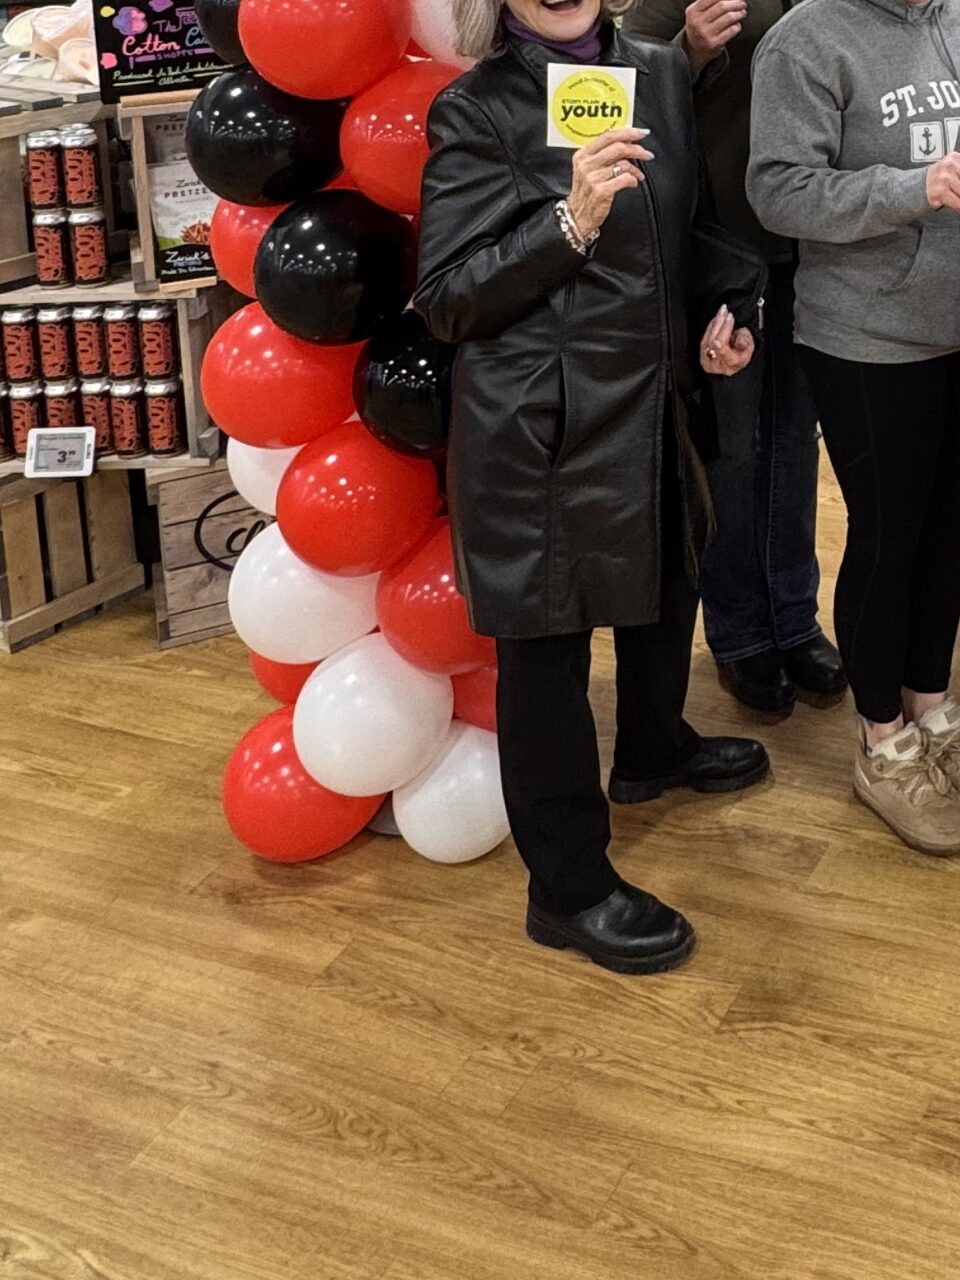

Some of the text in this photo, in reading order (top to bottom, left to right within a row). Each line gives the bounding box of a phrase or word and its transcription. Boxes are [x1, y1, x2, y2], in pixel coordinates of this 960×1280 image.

[122, 33, 180, 56] Cotton
[880, 83, 925, 128] ST.
[163, 186, 208, 199] PRETZE
